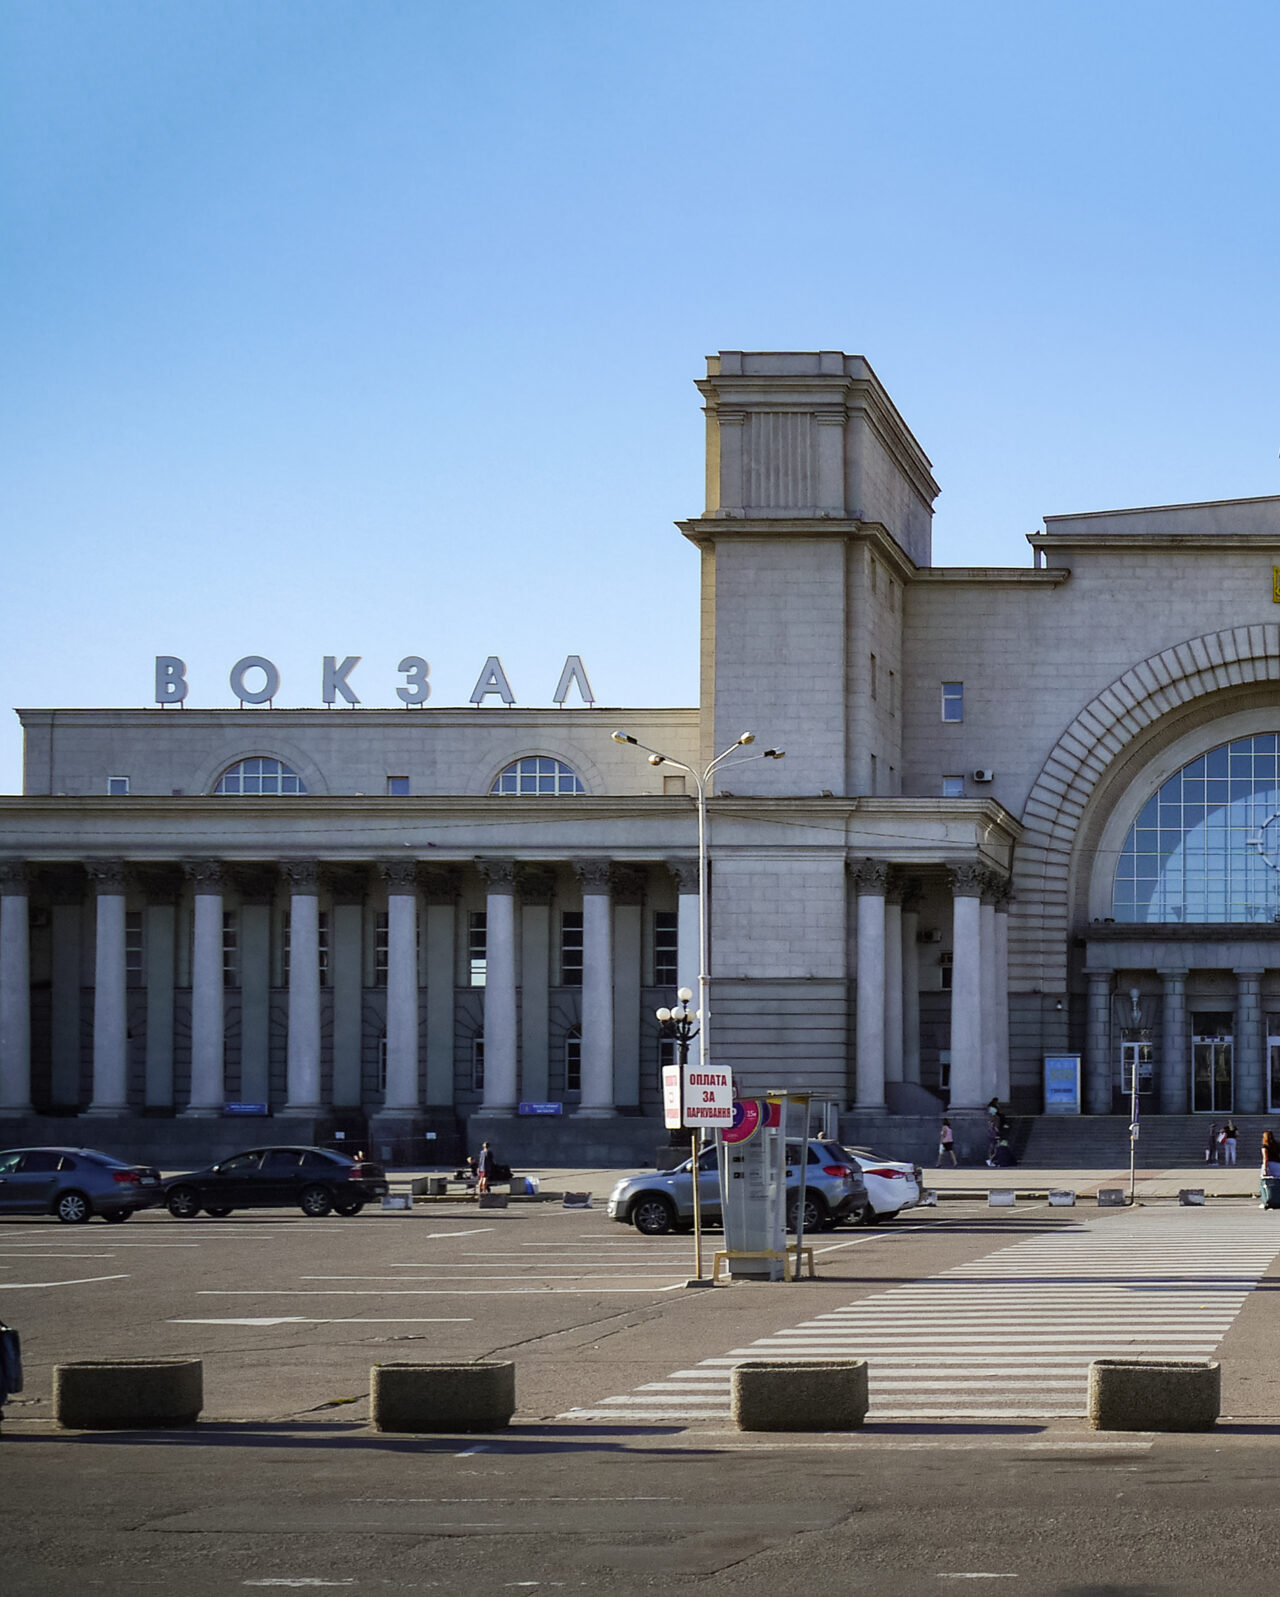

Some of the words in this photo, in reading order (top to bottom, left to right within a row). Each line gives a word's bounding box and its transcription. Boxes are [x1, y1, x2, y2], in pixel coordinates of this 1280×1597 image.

[155, 655, 596, 704] ВОКЗАЛ
[689, 1073, 727, 1086] ОПЛАТА
[702, 1090, 716, 1102] ЗА
